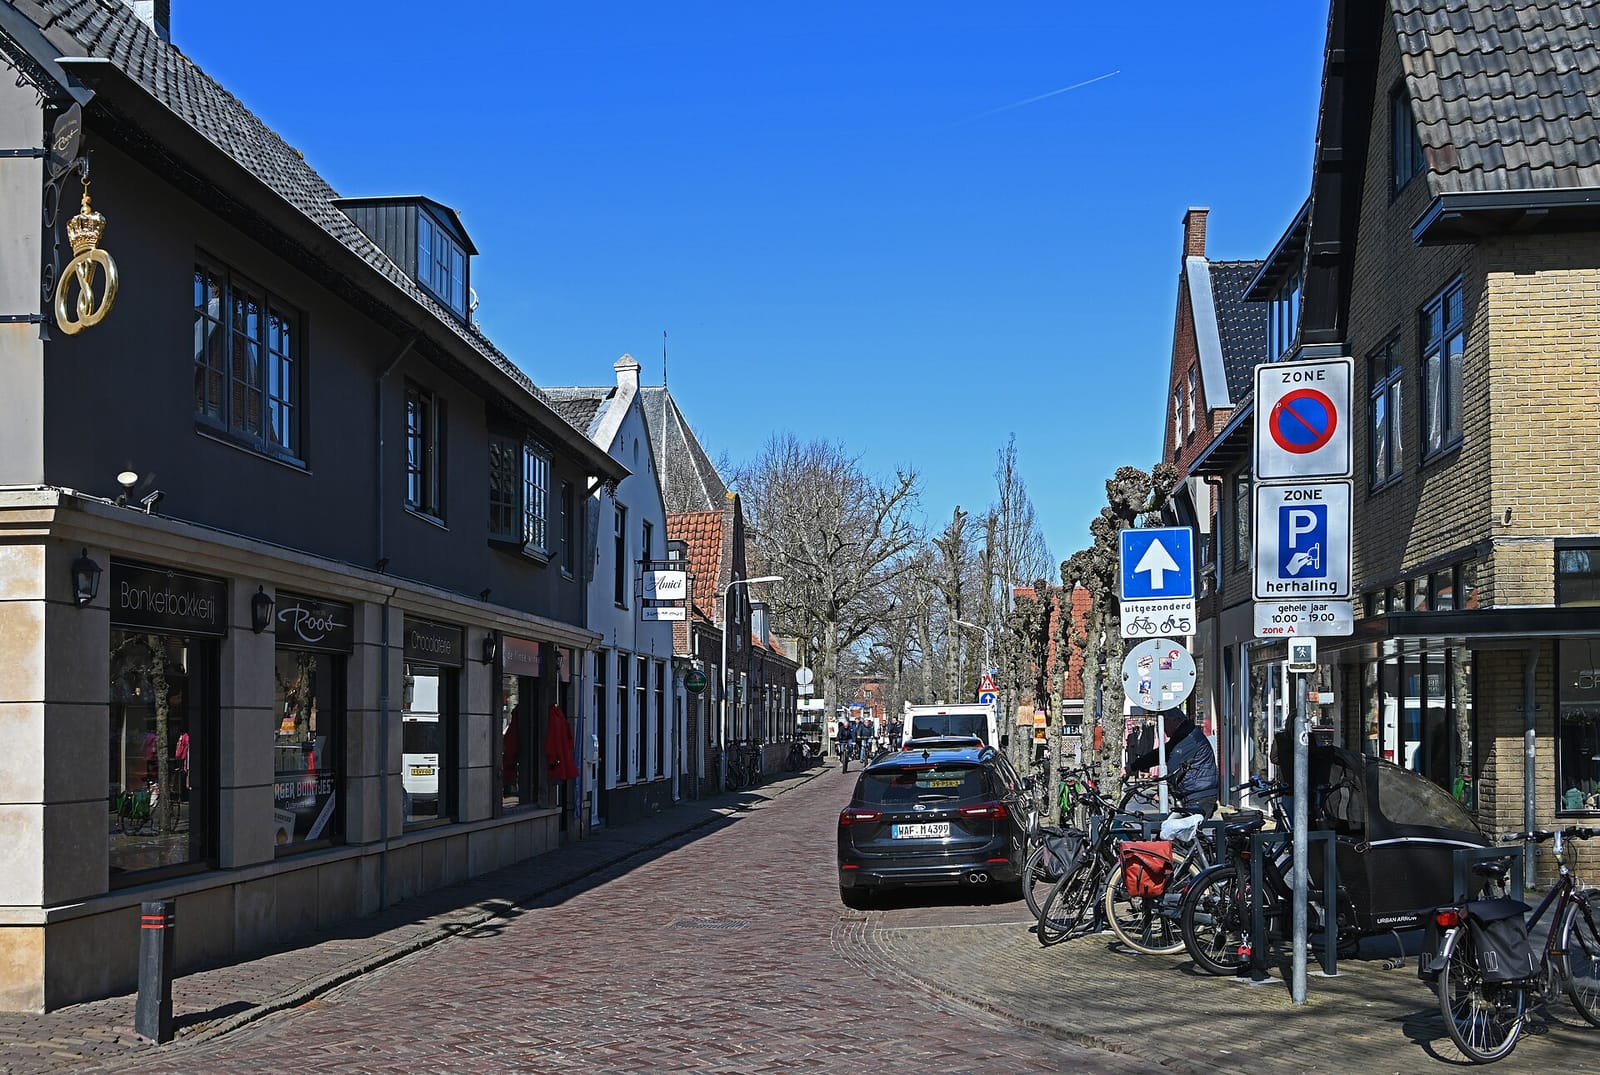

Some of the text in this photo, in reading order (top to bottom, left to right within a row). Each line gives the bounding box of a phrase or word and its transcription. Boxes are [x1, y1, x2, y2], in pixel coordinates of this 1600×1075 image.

[1282, 370, 1325, 383] ZONE
[1284, 489, 1322, 501] ZONE
[1288, 509, 1318, 549] P
[645, 575, 682, 592] Amici
[1266, 580, 1338, 595] herhaling
[121, 581, 215, 625] Banketbakkerij
[1125, 602, 1191, 614] uitgezonderd
[1278, 603, 1328, 614] gehele jaar
[277, 603, 348, 643] Roos
[1271, 614, 1298, 623] 10.00
[1308, 613, 1335, 622] 19.00
[1262, 625, 1295, 634] zone A
[927, 824, 949, 834] 4399
